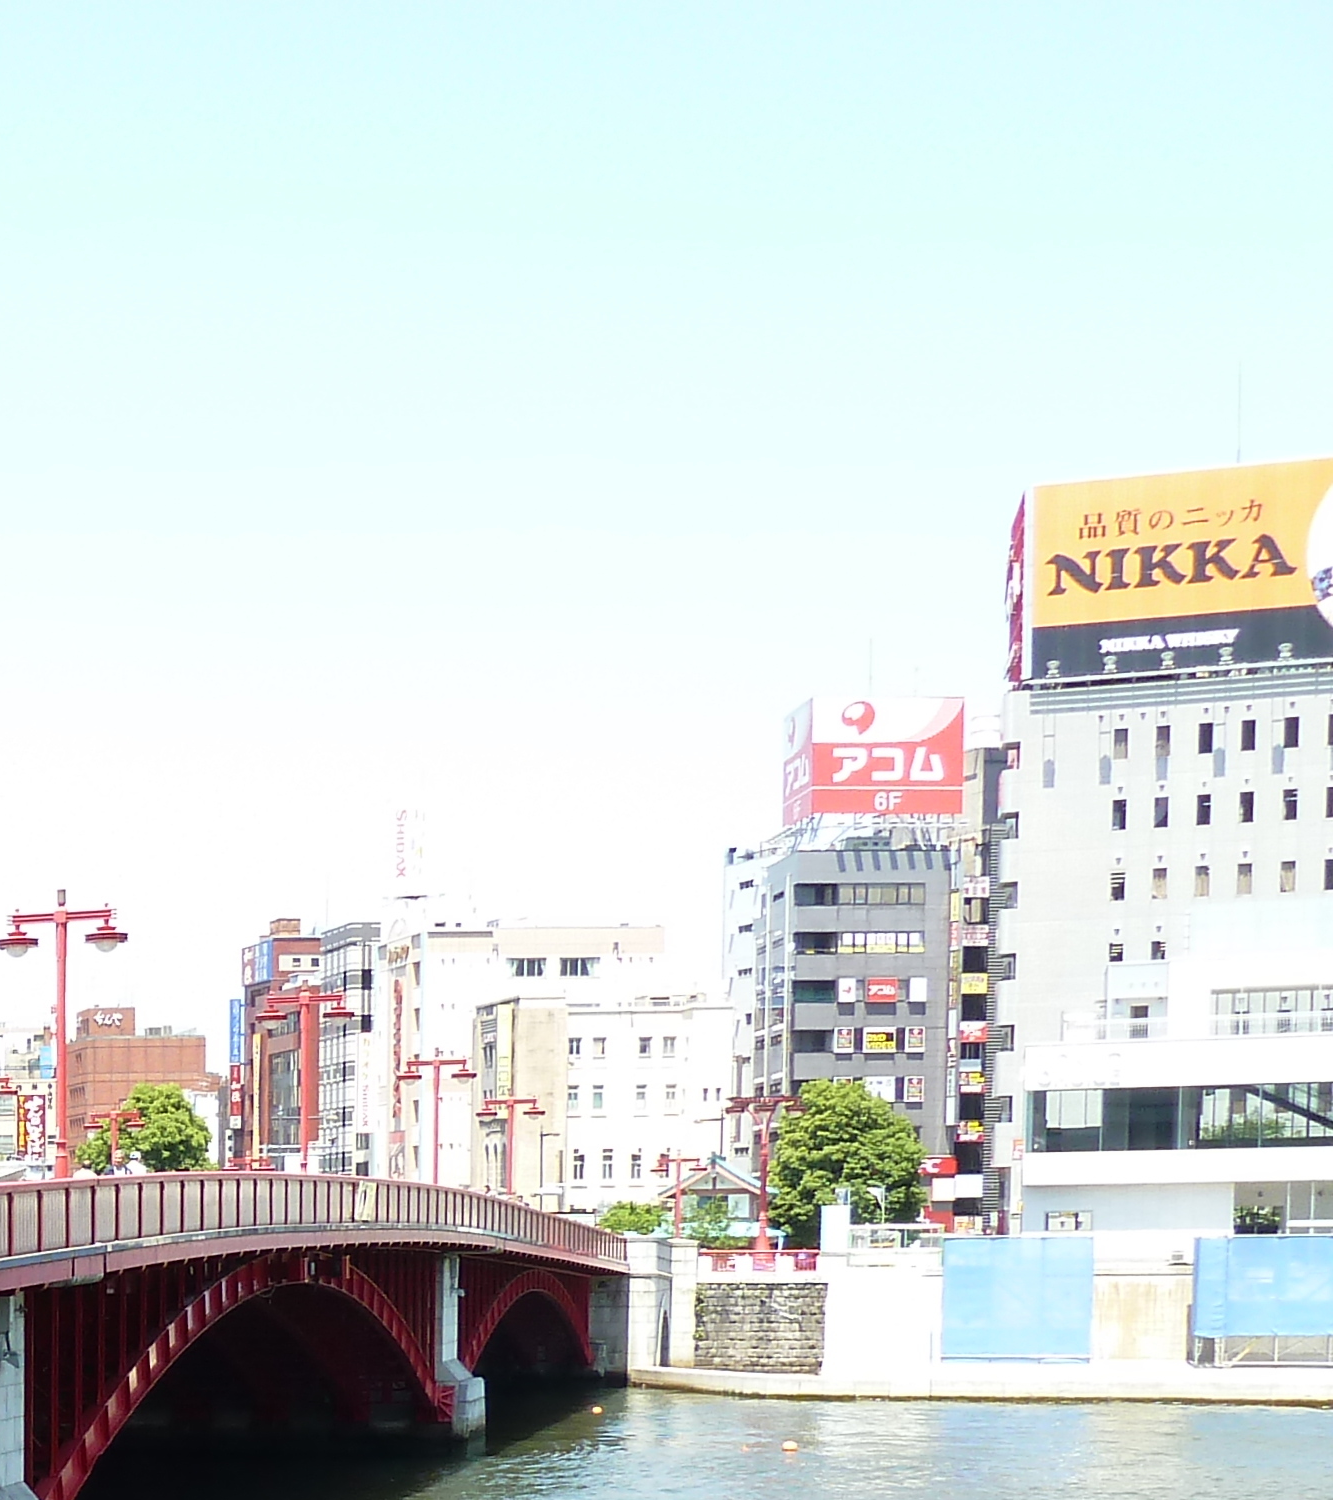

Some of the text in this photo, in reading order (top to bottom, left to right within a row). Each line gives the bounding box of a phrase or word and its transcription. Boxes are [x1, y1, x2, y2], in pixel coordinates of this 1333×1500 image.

[1078, 499, 1264, 540] 品質のニッカ
[1045, 533, 1298, 597] NIKKA
[831, 746, 945, 783] アコム
[874, 791, 903, 811] 6F
[868, 984, 896, 996] アコム
